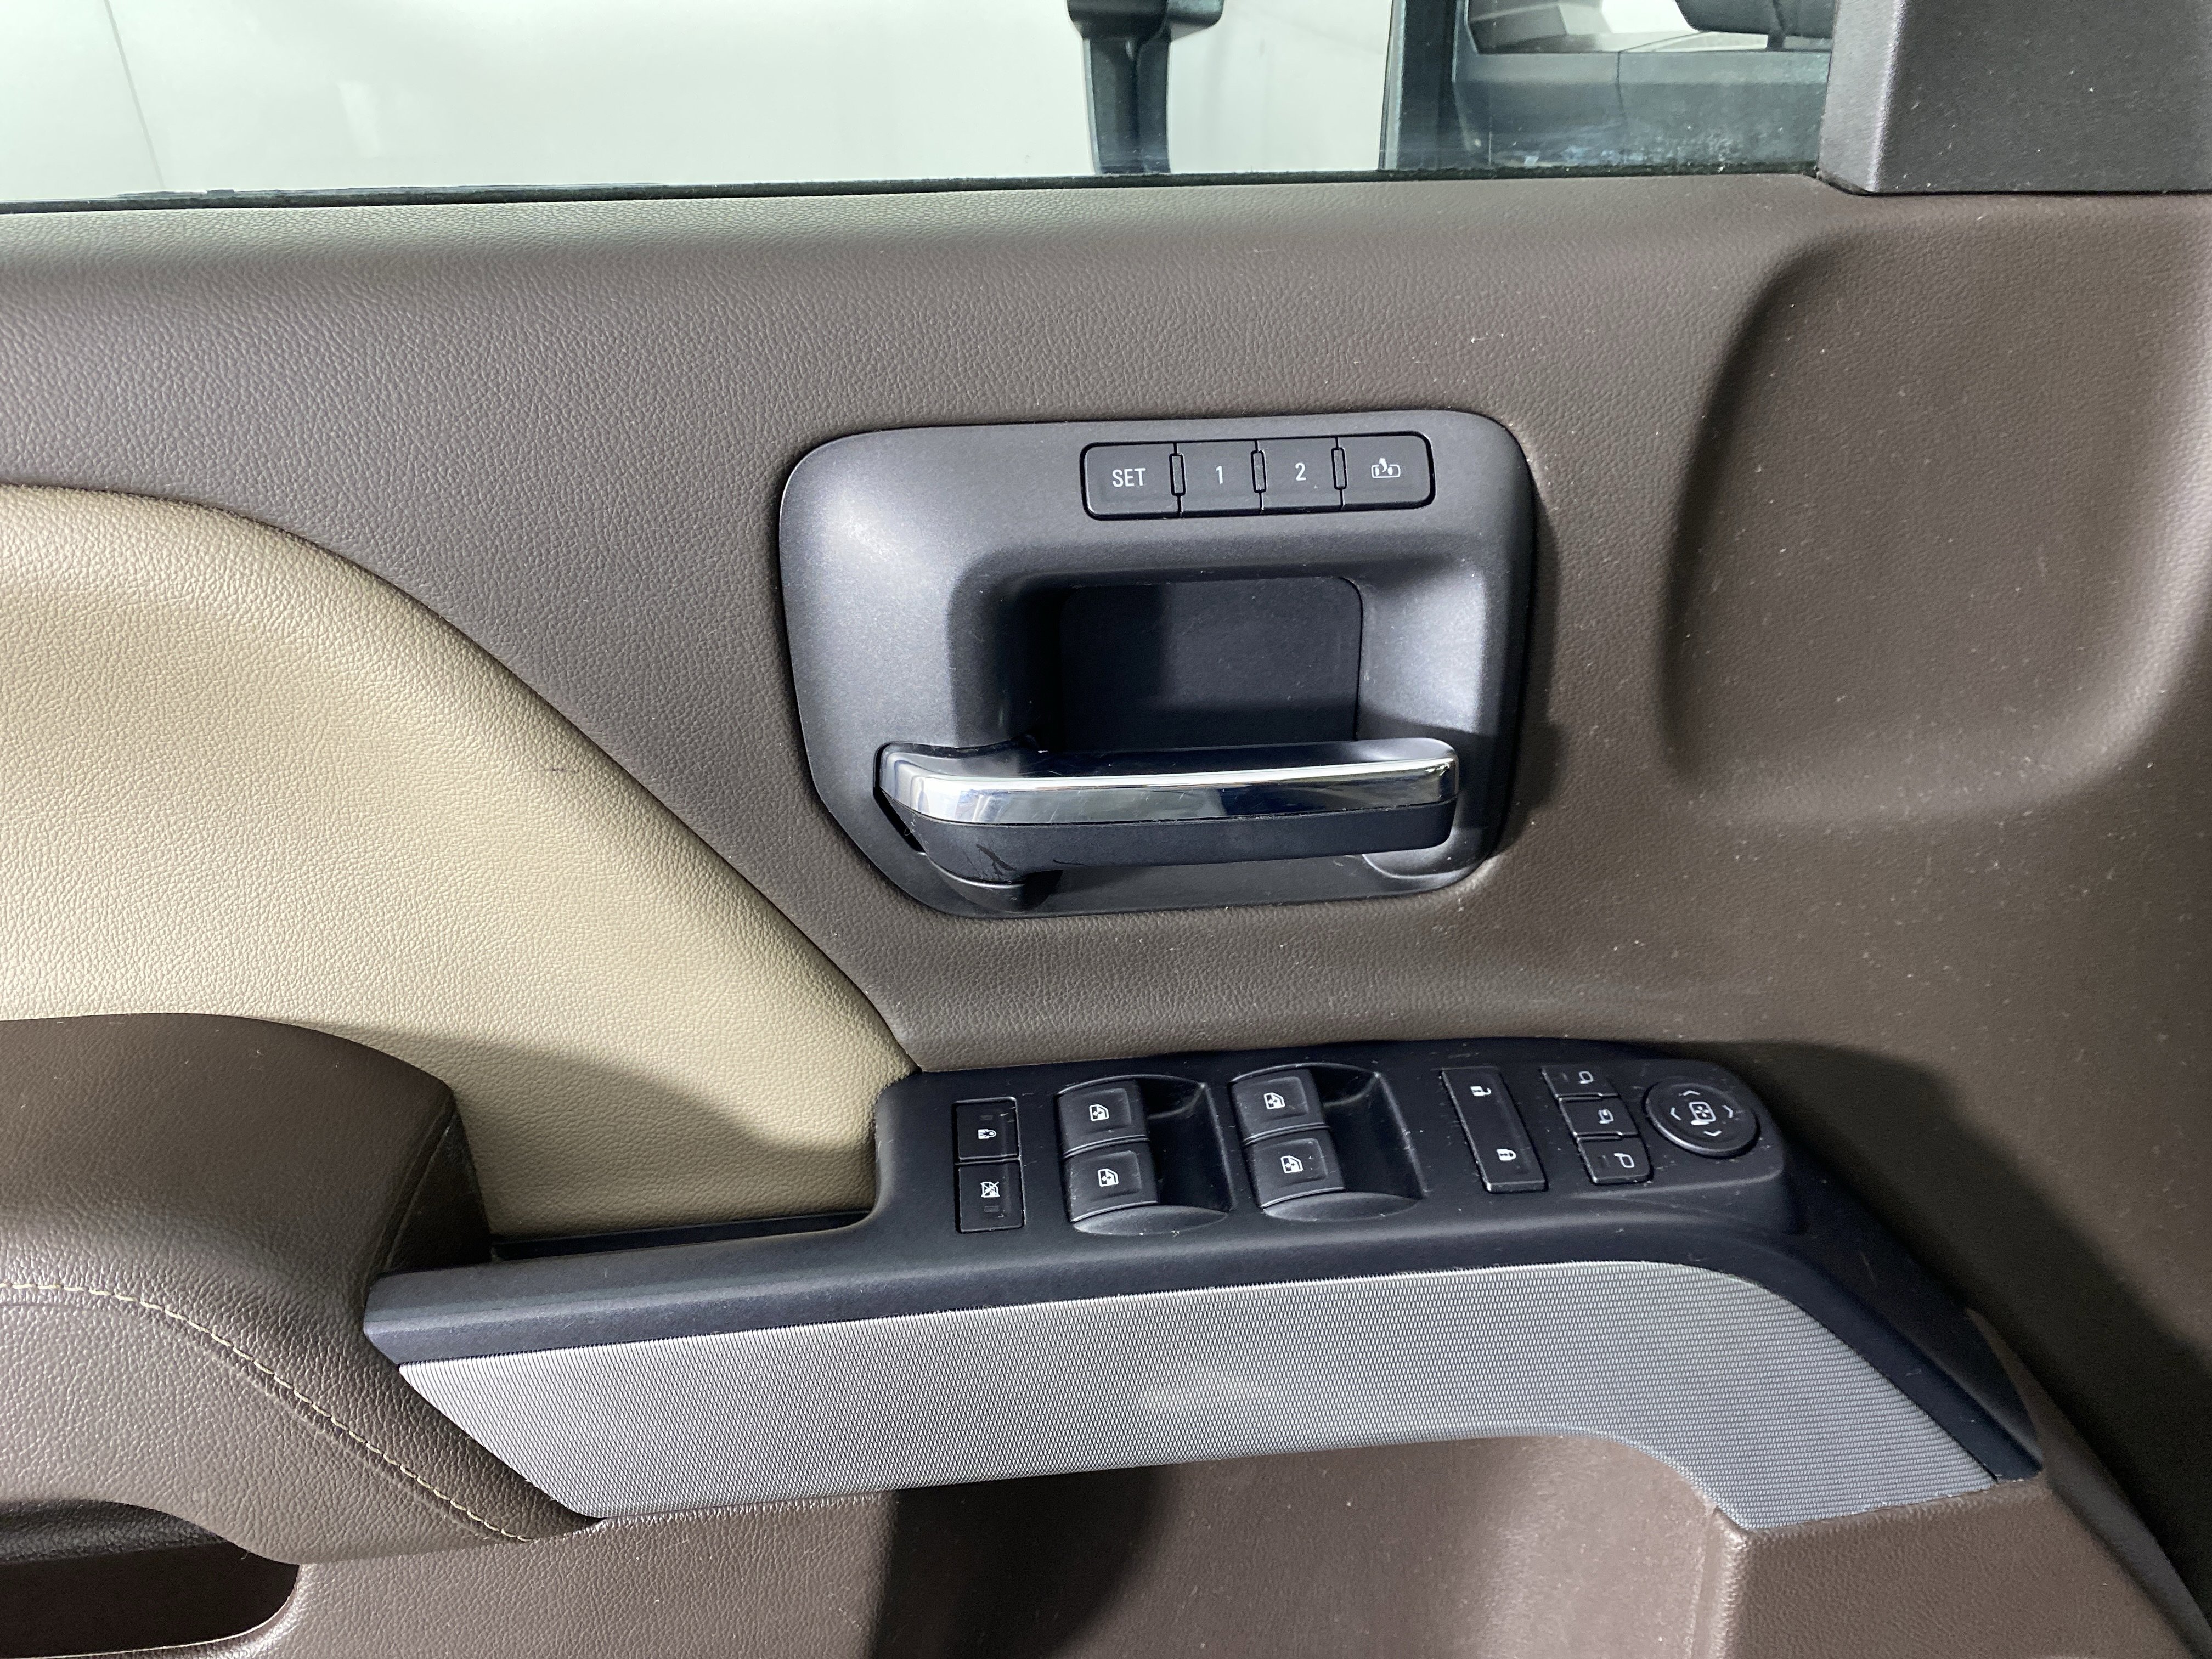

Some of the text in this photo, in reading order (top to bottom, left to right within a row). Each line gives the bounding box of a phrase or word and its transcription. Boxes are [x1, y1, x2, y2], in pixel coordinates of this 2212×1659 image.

[1112, 467, 1146, 487] SET
[1215, 466, 1224, 484] 1
[1295, 462, 1307, 481] 2
